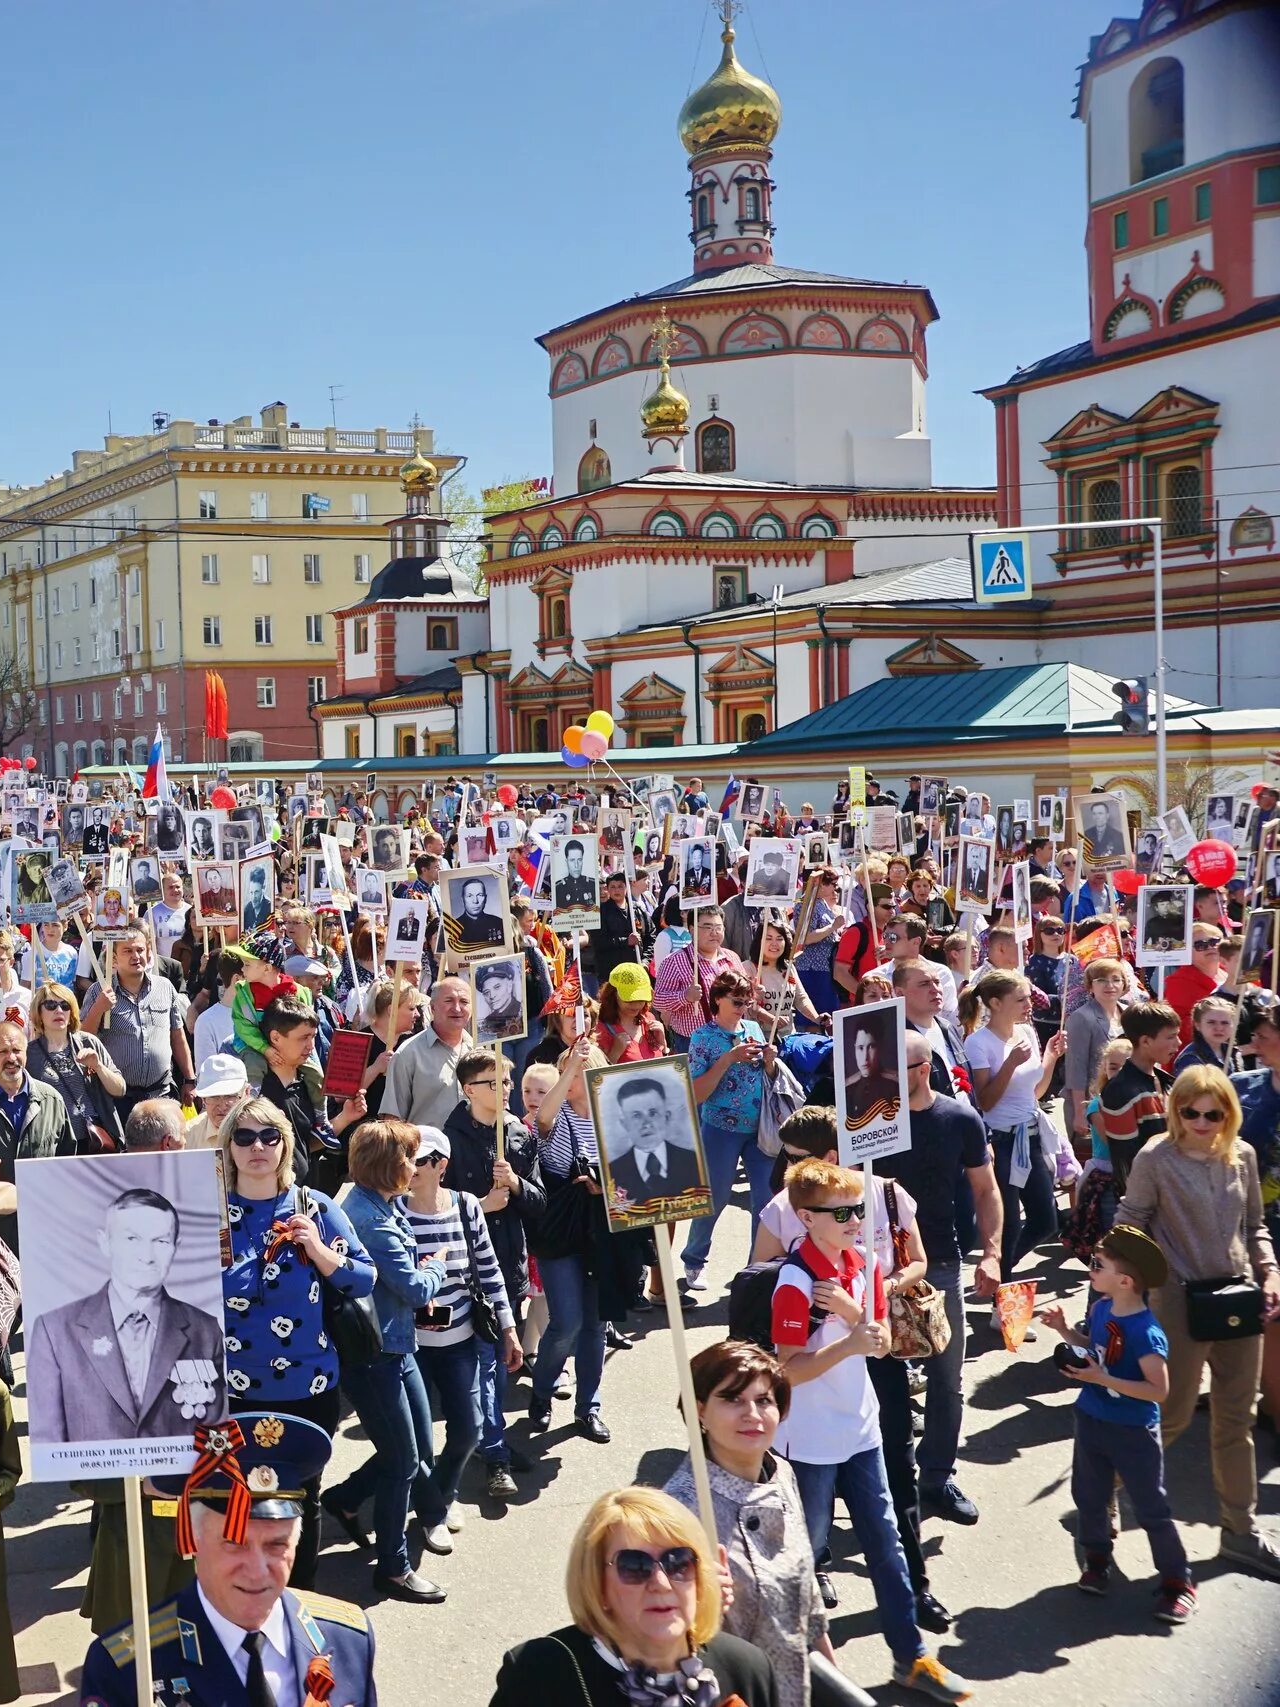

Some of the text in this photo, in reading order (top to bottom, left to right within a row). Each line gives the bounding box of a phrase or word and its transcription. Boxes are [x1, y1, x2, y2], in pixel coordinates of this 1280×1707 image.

[764, 991, 777, 999] OU
[851, 1124, 898, 1145] БОРОВСКОЙ
[852, 1136, 898, 1152] Александр Иванович
[51, 1444, 194, 1459] СТЕШЕНКО ИВАН ГРИГОРЬЕВ
